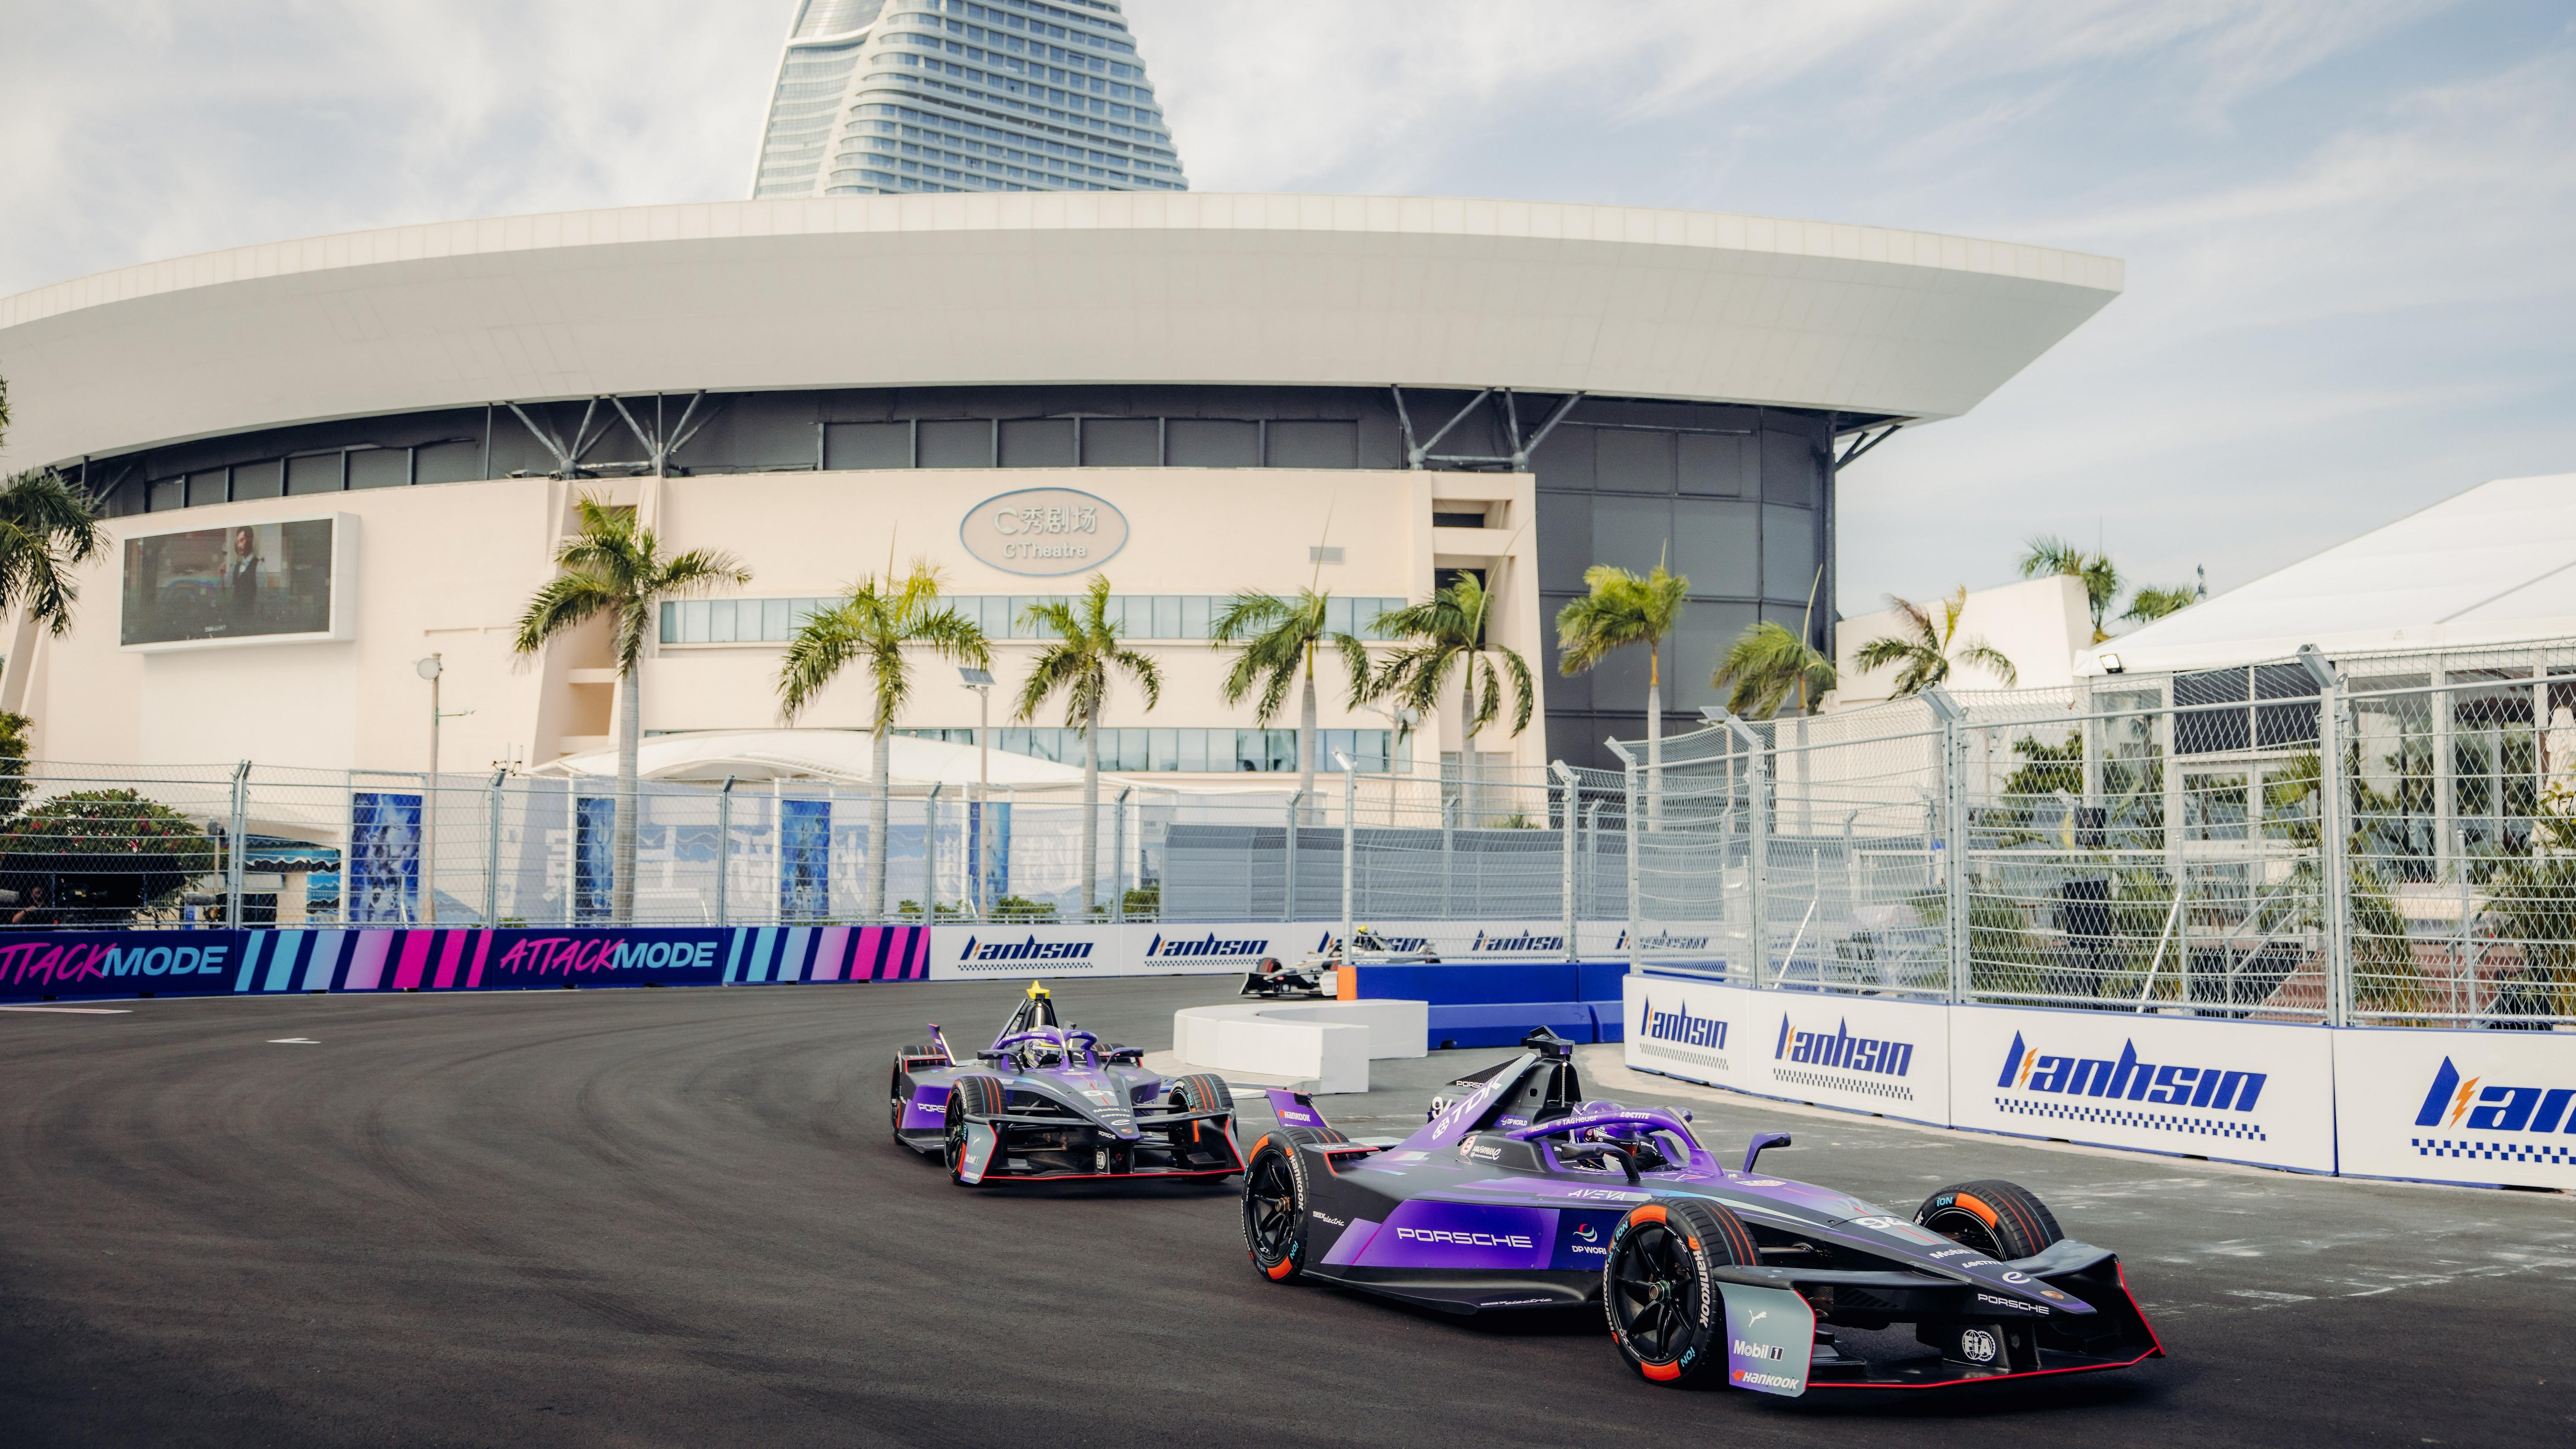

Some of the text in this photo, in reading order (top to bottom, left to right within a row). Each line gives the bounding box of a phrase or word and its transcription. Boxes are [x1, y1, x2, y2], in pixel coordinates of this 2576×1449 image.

[994, 506, 1097, 535] C秀剧场
[1003, 542, 1087, 558] C Theatre
[0, 943, 228, 986] TTACK MODE
[499, 937, 718, 976] ATTACK MODE
[1452, 1068, 1508, 1124] TDK
[917, 1103, 946, 1113] PORS
[1098, 1131, 1116, 1140] PORSCHE
[1567, 1189, 1626, 1201] AVEVA
[1936, 1196, 1953, 1207] iON
[1616, 1220, 1628, 1240] iON
[1856, 1216, 1913, 1229] 94
[1397, 1227, 1533, 1248] PORSCHE
[1584, 1246, 1607, 1255] WORL
[1929, 1249, 1968, 1259] Mobil
[1978, 1293, 2050, 1315] PORSCHE
[1629, 1346, 1640, 1358] RACING
[1680, 1346, 1695, 1367] iON
[1734, 1339, 1784, 1361] Mobil 1
